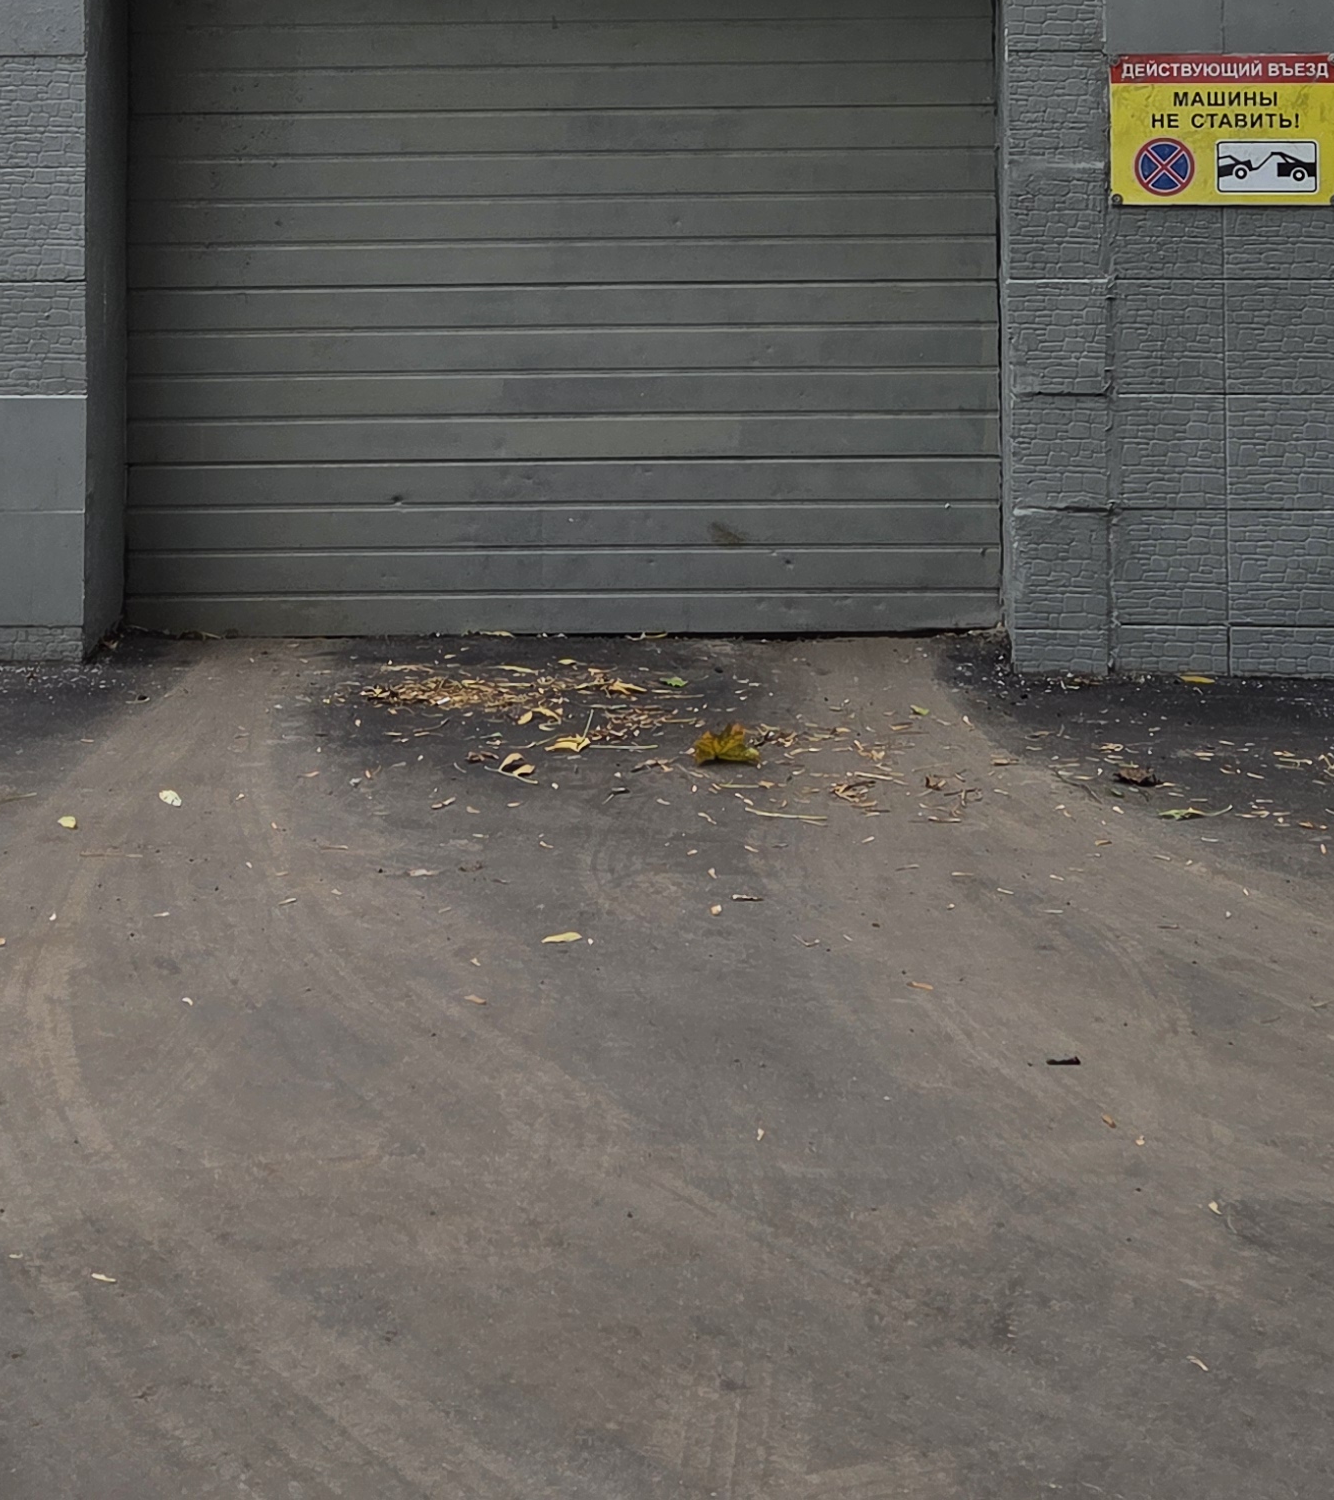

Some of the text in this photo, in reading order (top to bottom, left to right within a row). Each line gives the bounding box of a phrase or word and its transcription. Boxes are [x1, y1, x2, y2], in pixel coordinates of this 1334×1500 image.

[1121, 60, 1329, 79] ДЕЙСТВУЮЩИЙ ВЪЕЗД
[1173, 91, 1278, 107] МАШИНЫ
[1151, 113, 1300, 129] НЕ СТАВИТЬ!
